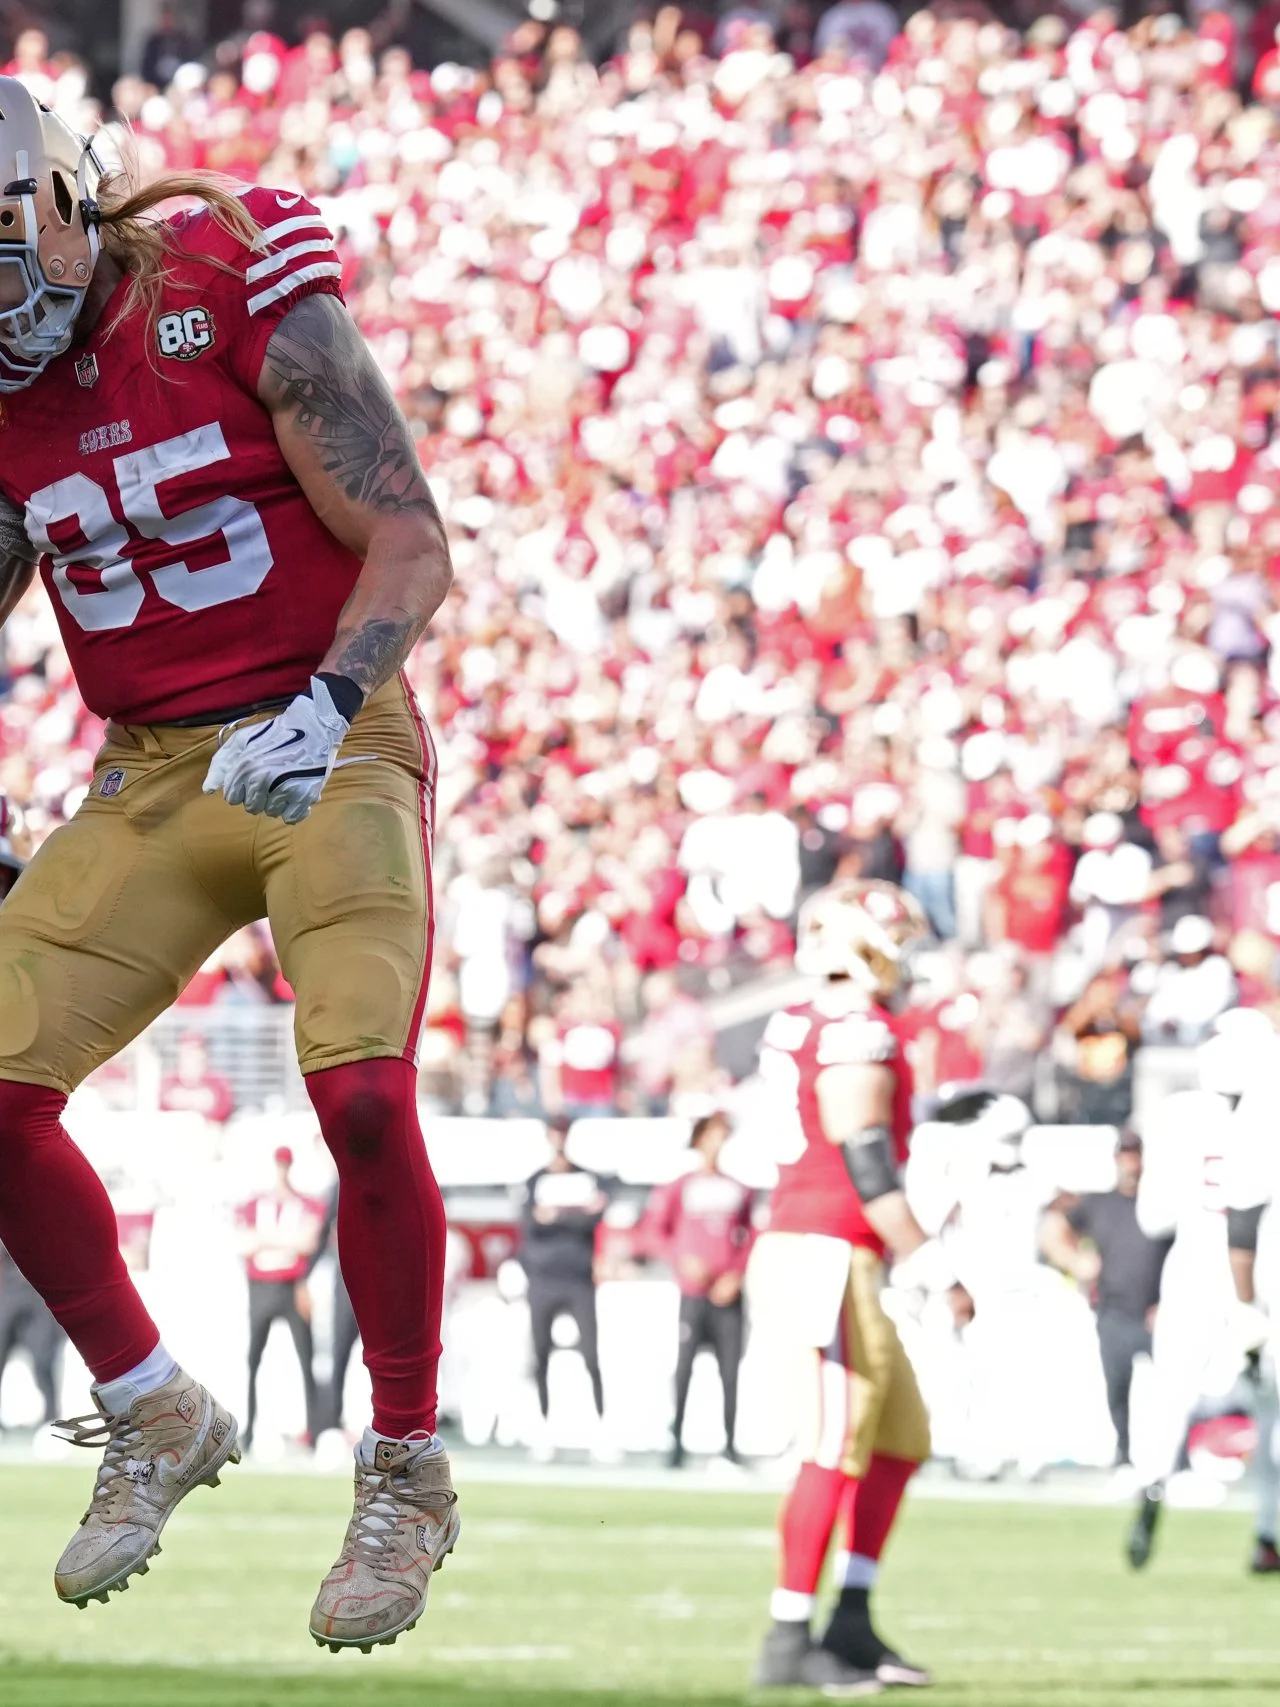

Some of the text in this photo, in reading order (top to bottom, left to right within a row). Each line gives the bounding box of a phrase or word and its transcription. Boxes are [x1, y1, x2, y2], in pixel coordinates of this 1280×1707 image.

[79, 367, 95, 382] NFL
[78, 419, 133, 456] 49ERS
[24, 421, 274, 631] 85
